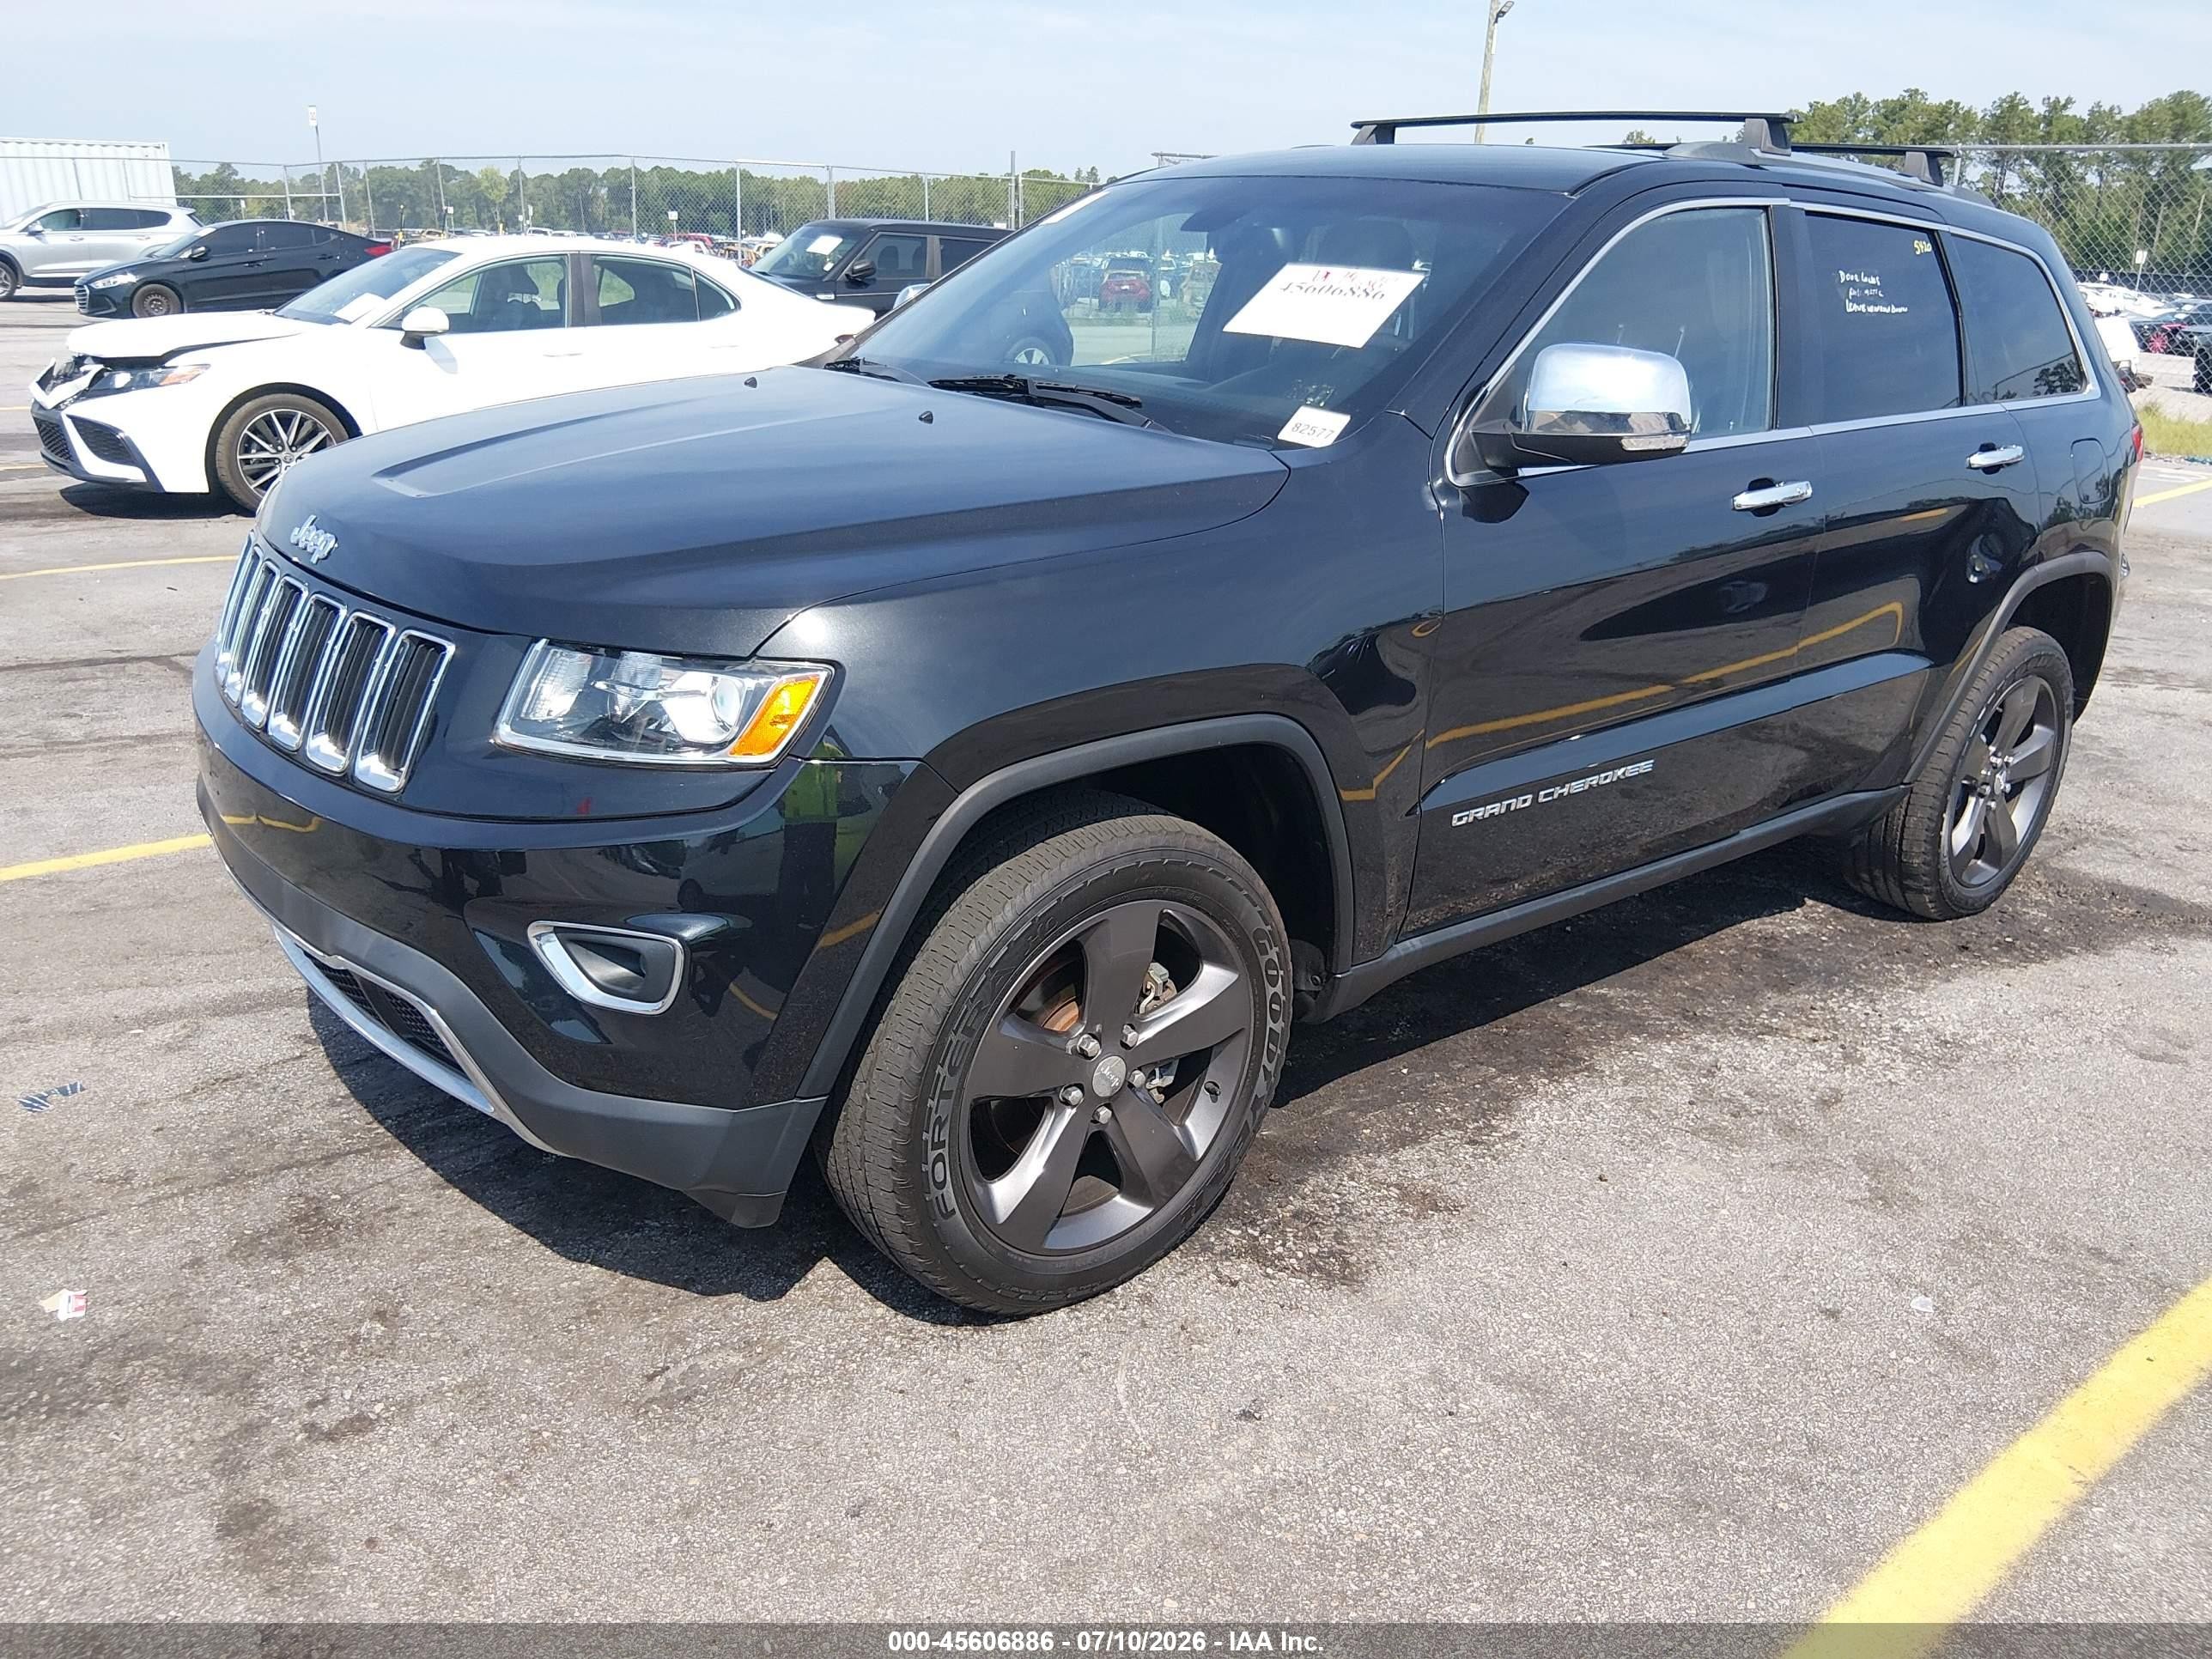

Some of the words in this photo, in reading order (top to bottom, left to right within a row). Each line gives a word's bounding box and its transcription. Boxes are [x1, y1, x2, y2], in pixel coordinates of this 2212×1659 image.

[1291, 422, 1335, 440] 82577
[1451, 793, 1534, 827] GRAND
[1538, 759, 1655, 804] CHEROKEE
